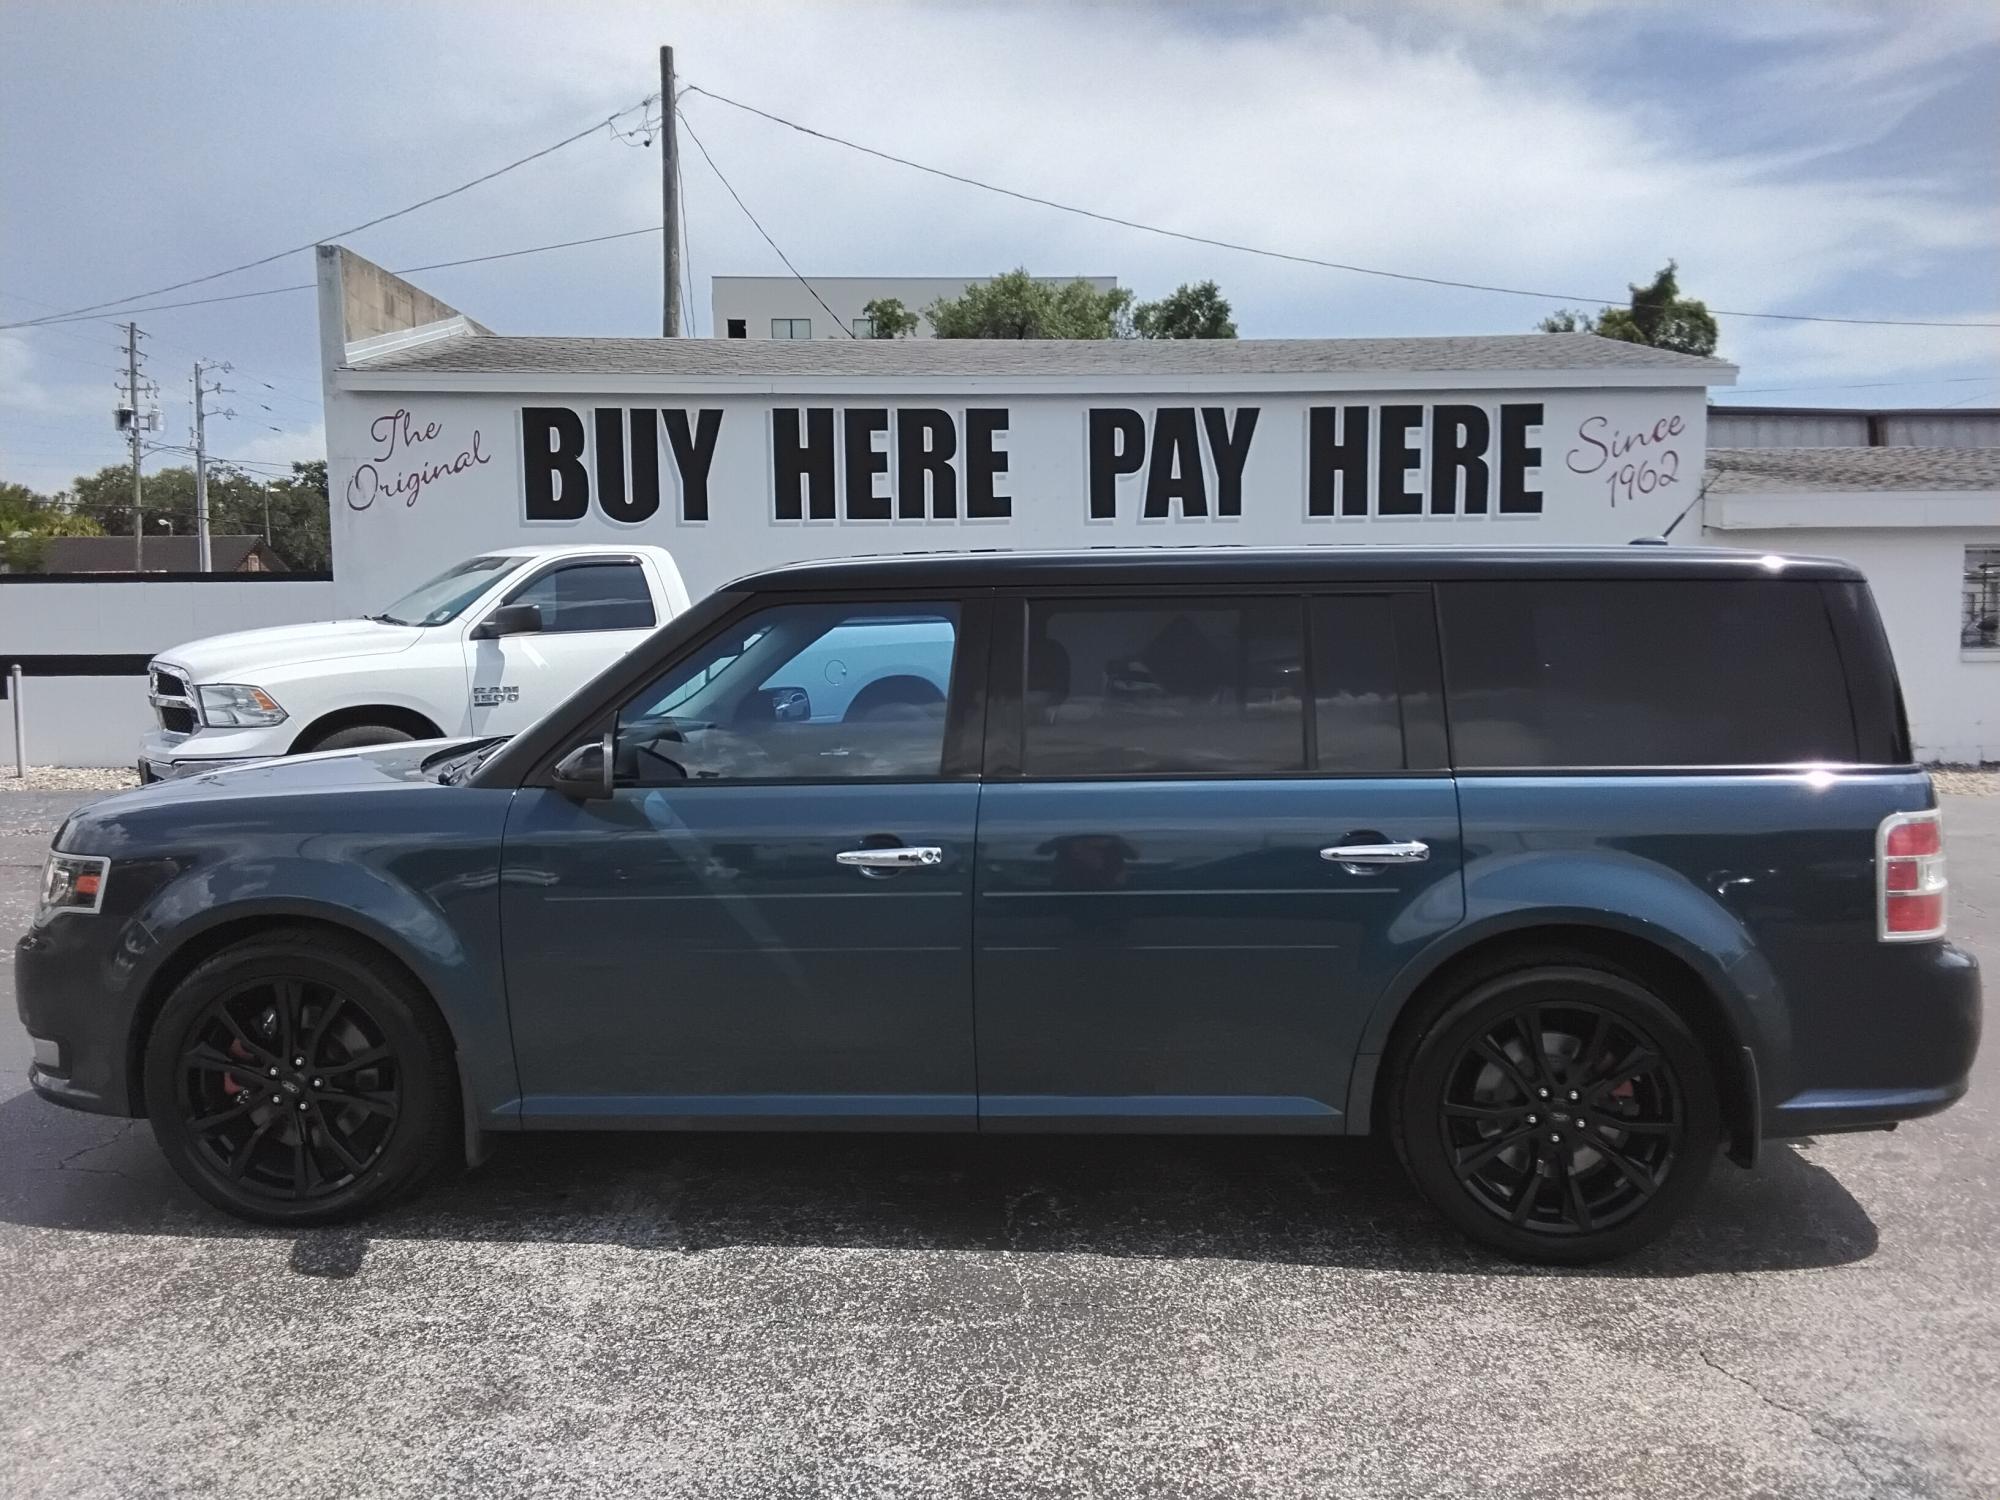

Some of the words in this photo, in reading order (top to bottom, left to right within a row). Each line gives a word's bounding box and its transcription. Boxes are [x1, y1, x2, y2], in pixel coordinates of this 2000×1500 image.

[371, 408, 442, 462] The
[521, 406, 724, 523] BUY
[772, 407, 1012, 520] HERE
[1089, 407, 1261, 519] PAY
[1309, 403, 1544, 517] HERE
[1566, 415, 1686, 474] Since
[346, 430, 491, 511] Original
[1606, 450, 1679, 508] 1962
[473, 694, 519, 702] 1500
